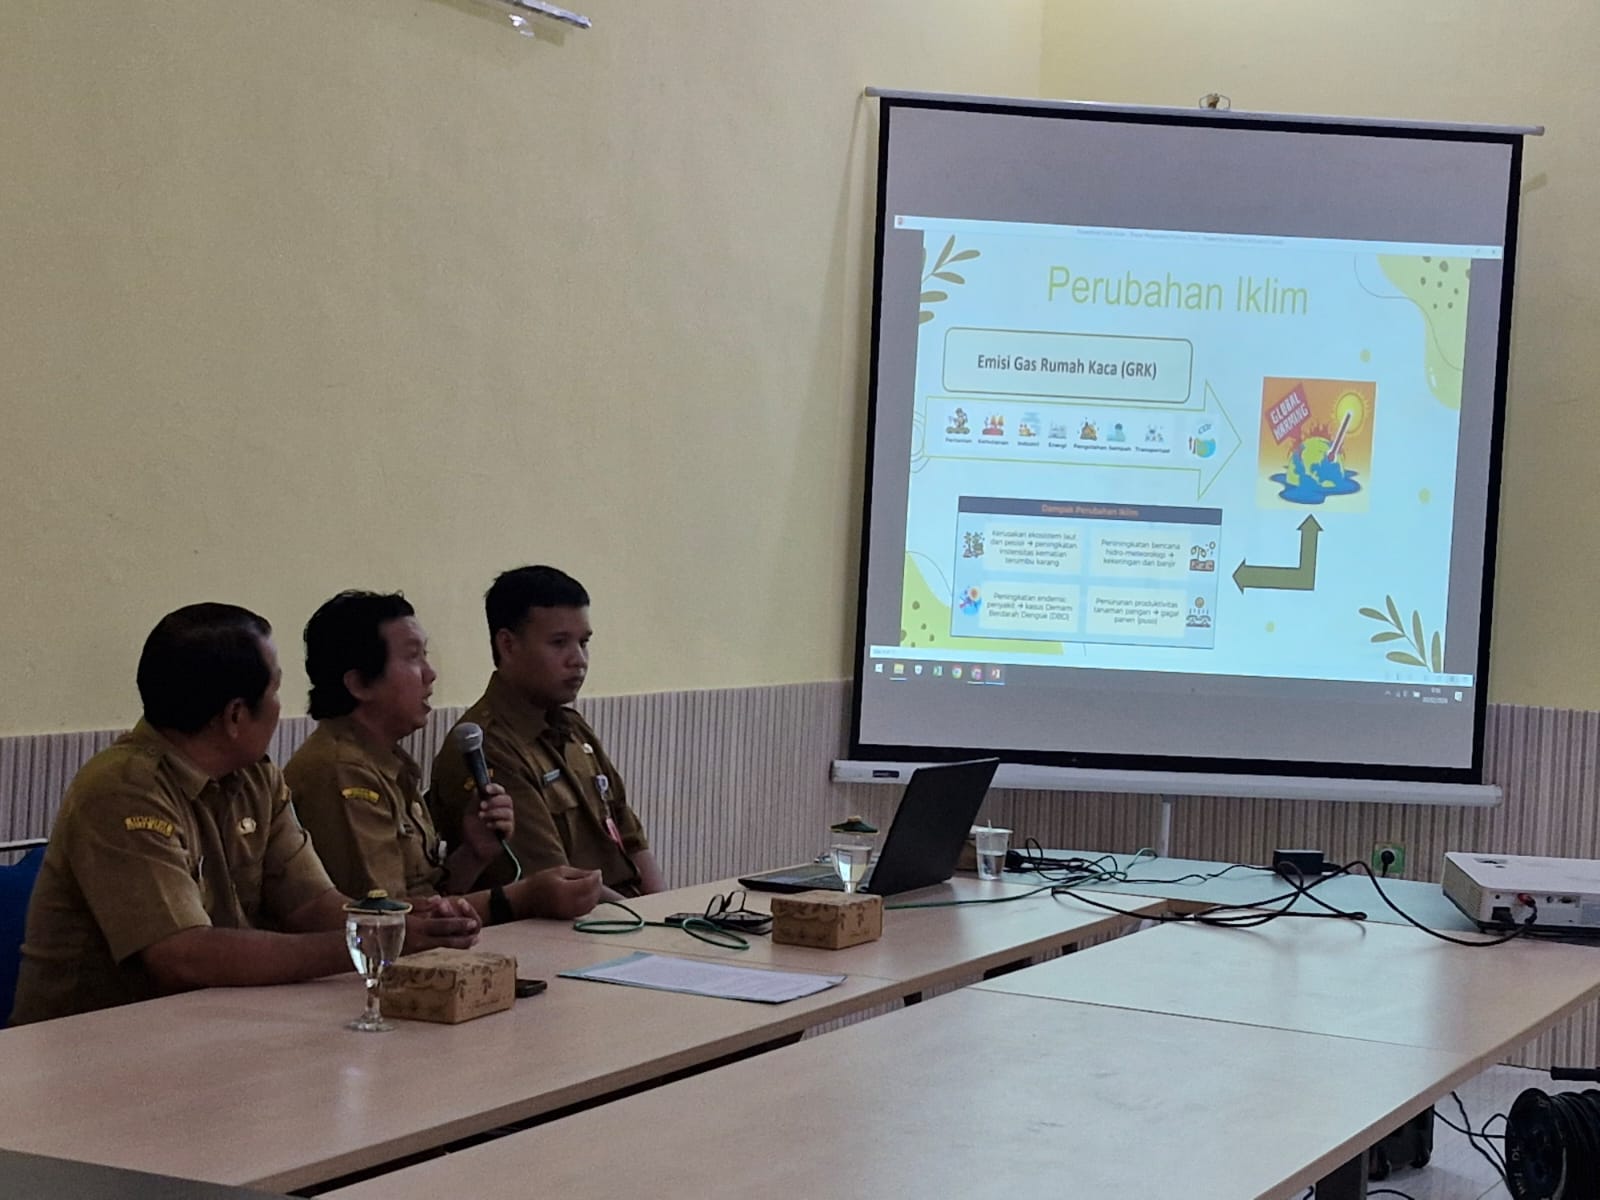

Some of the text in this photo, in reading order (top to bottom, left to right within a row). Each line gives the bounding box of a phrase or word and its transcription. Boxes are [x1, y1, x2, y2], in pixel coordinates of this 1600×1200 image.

[1047, 265, 1309, 315] Perubahan Iklim
[977, 354, 1157, 380] Emisi Gas Rumah Kaca (GRK)
[1270, 391, 1301, 425] GLOBAL
[1273, 402, 1309, 441] WARMING
